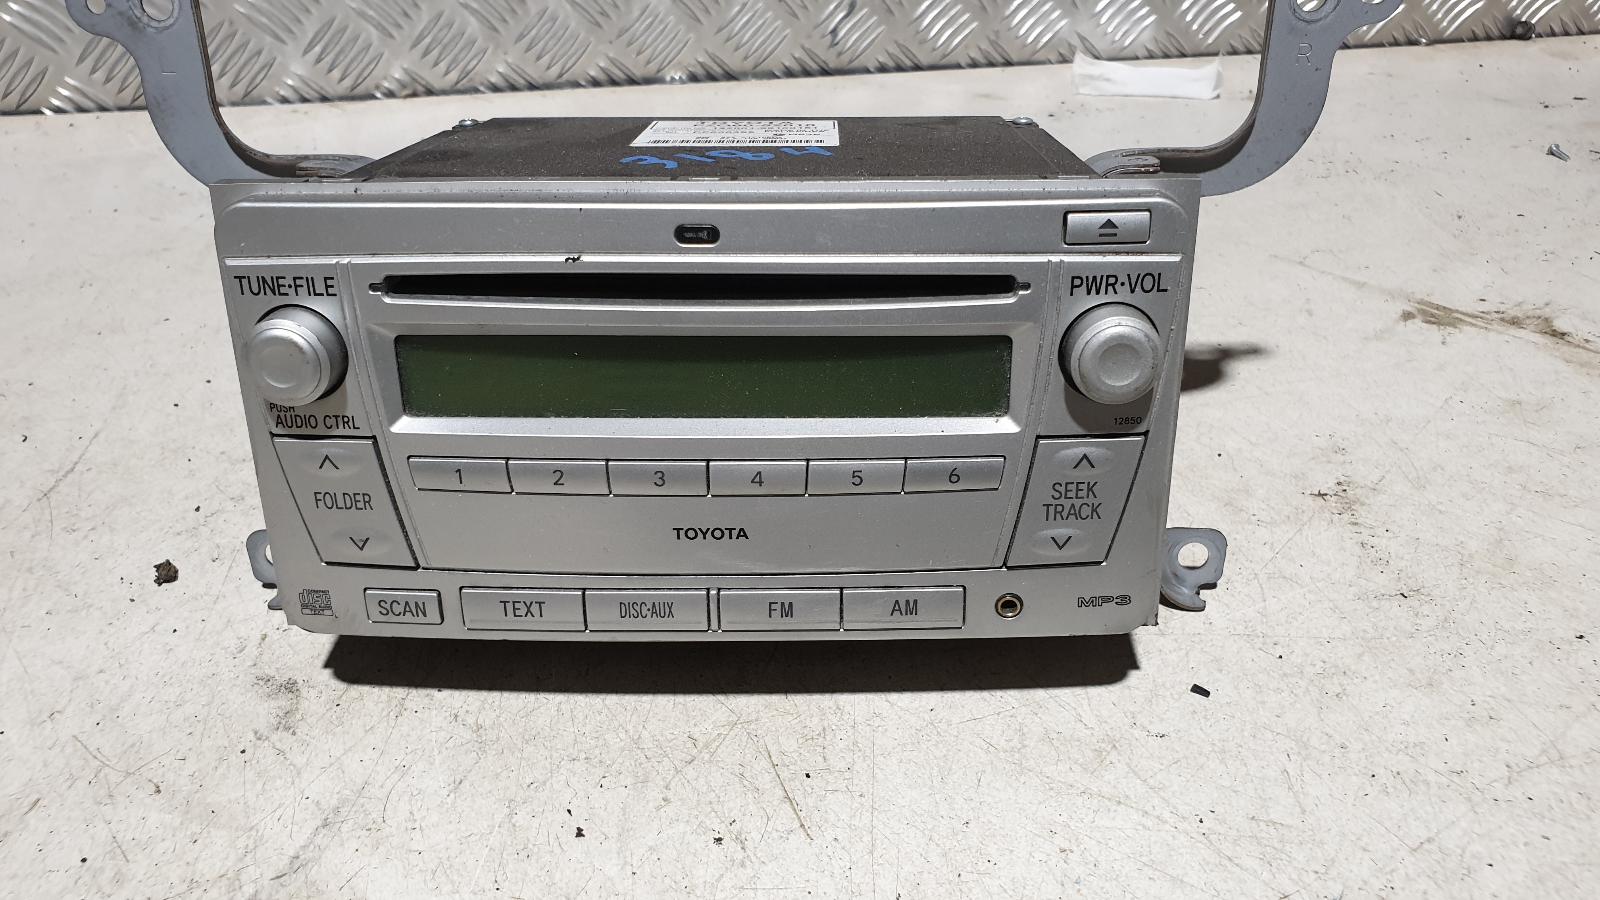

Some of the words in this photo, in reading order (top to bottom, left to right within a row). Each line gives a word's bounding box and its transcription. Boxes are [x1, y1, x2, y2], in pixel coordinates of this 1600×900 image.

[269, 402, 296, 413] PUSH
[276, 414, 319, 429] AUDIO
[323, 414, 360, 430] CTRL
[1113, 416, 1142, 425] 12850
[455, 469, 463, 485] 1
[553, 470, 564, 486] 2
[654, 471, 666, 487] 3
[751, 471, 765, 486] 4
[851, 471, 863, 487] 5
[948, 468, 960, 484] 6
[1051, 482, 1098, 500] SEEK
[313, 491, 374, 511] FOLDER
[1043, 502, 1102, 521] TRACK
[672, 527, 749, 541] TOYOTA
[378, 599, 428, 618] SCAN
[500, 600, 546, 618] TEXT
[891, 599, 918, 617] AM
[1077, 594, 1132, 608] MP3
[768, 601, 794, 619] FM
